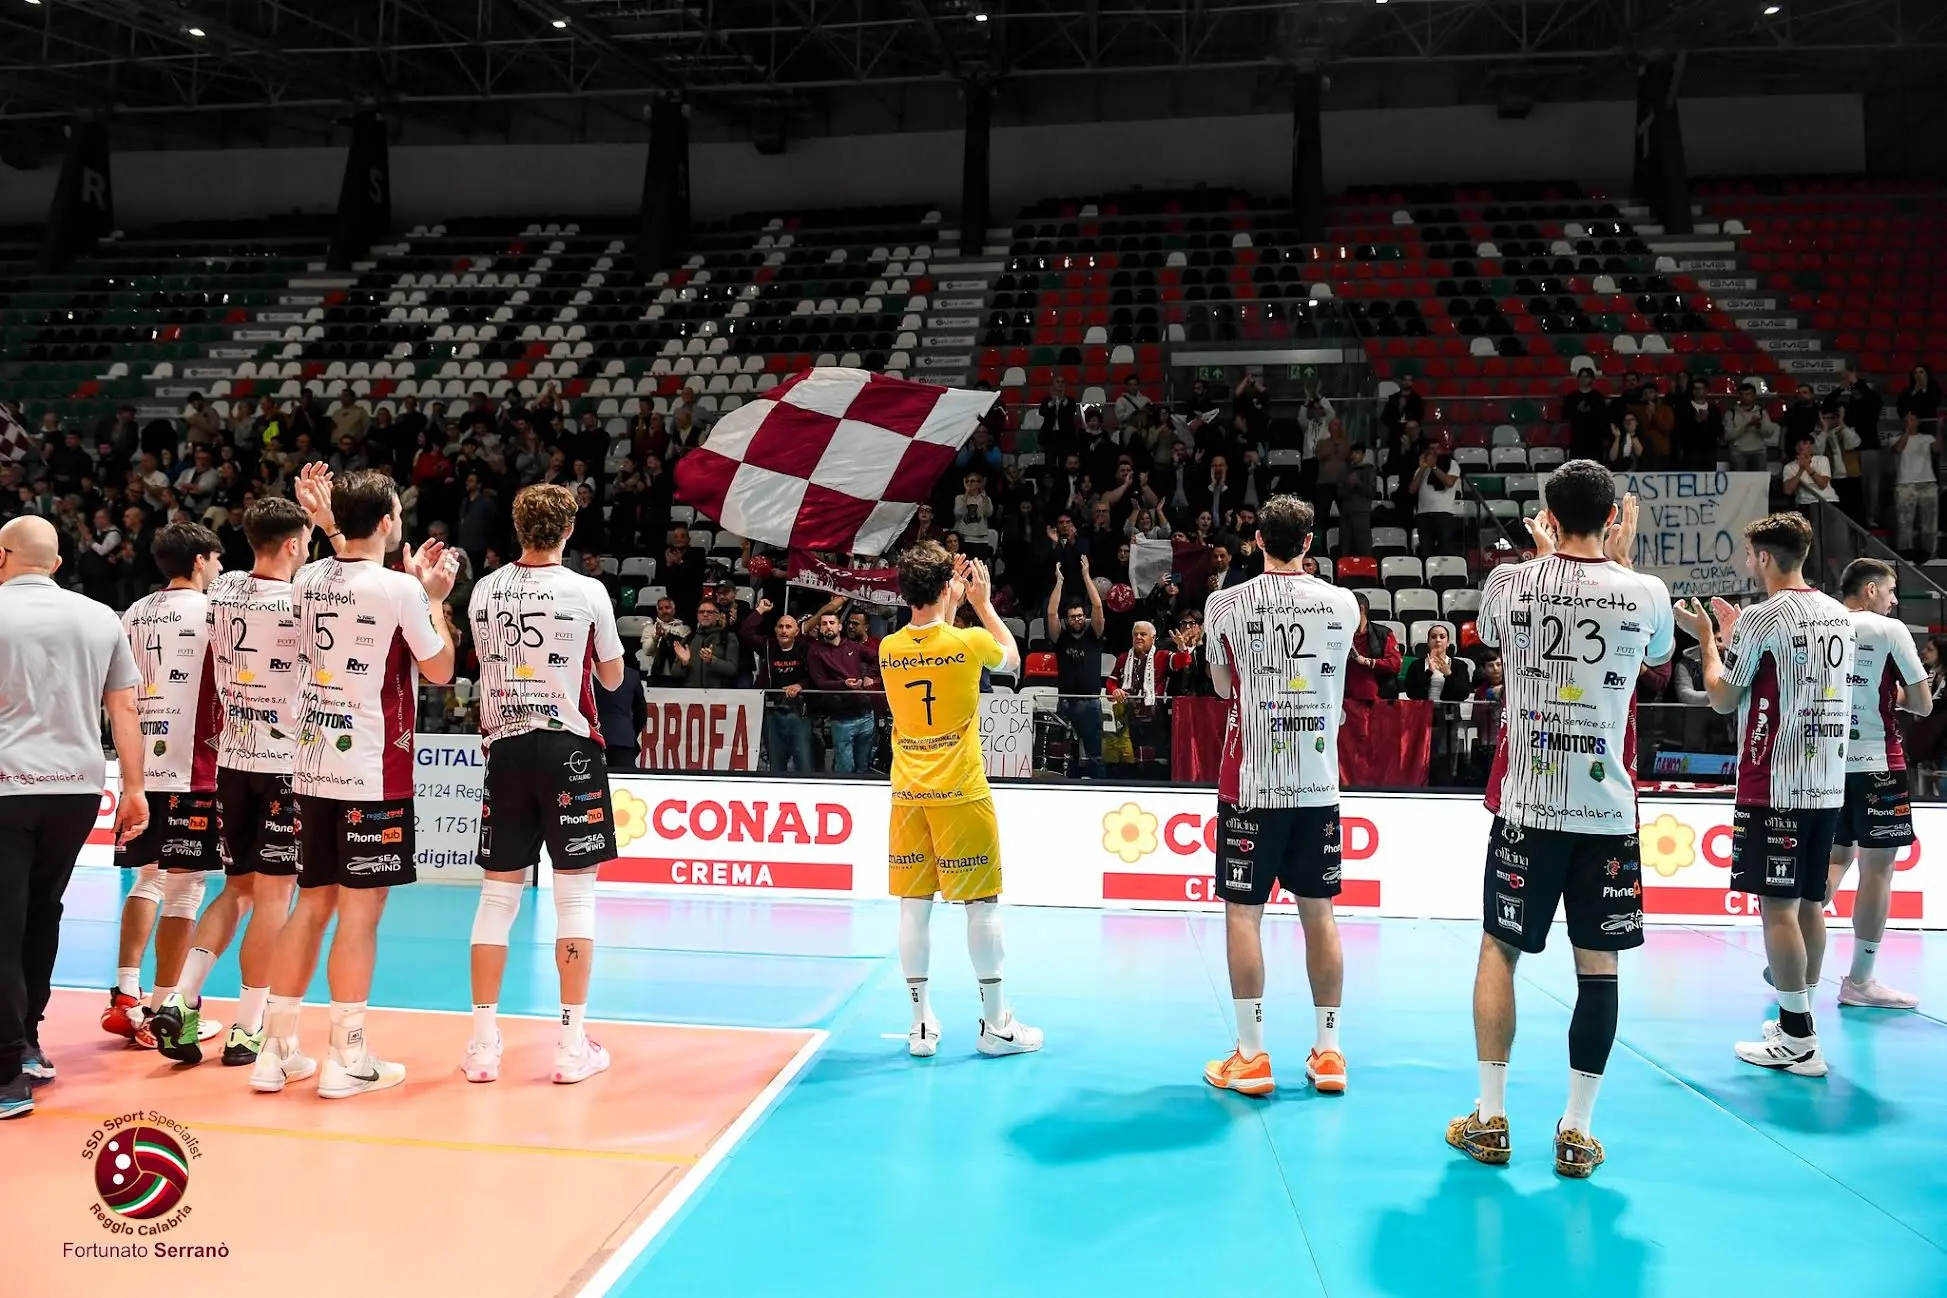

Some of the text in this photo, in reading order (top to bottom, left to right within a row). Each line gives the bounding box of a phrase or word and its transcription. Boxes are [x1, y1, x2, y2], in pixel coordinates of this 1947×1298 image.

[1690, 566, 1737, 580] CURVA
[304, 590, 356, 606] #zappoli
[491, 588, 554, 602] #parrini
[1518, 591, 1637, 612] #lazzaretto
[1255, 601, 1334, 615] #ciaramita
[132, 611, 182, 627] #spinello
[231, 617, 258, 653] 2
[315, 612, 339, 651] 5
[496, 611, 546, 648] 35
[1275, 623, 1317, 659] 12
[1541, 615, 1606, 665] 23
[145, 633, 162, 666] 4
[1817, 634, 1844, 668] 10
[881, 652, 965, 671] #lopetrone
[521, 690, 549, 699] service
[904, 679, 936, 726] 7
[989, 699, 1030, 715] COSE
[1009, 717, 1034, 734] DA
[1270, 716, 1325, 733] 2FMOTORS
[1564, 718, 1599, 729] service
[1530, 730, 1606, 755] 2FMOTORS
[1515, 802, 1623, 820] #reggiocalabria
[652, 799, 853, 845] CONAD
[1889, 830, 1912, 838] WIND
[176, 848, 202, 857] WIND
[378, 854, 401, 862] SEA
[372, 864, 402, 873] WIND
[671, 861, 774, 887] CREMA
